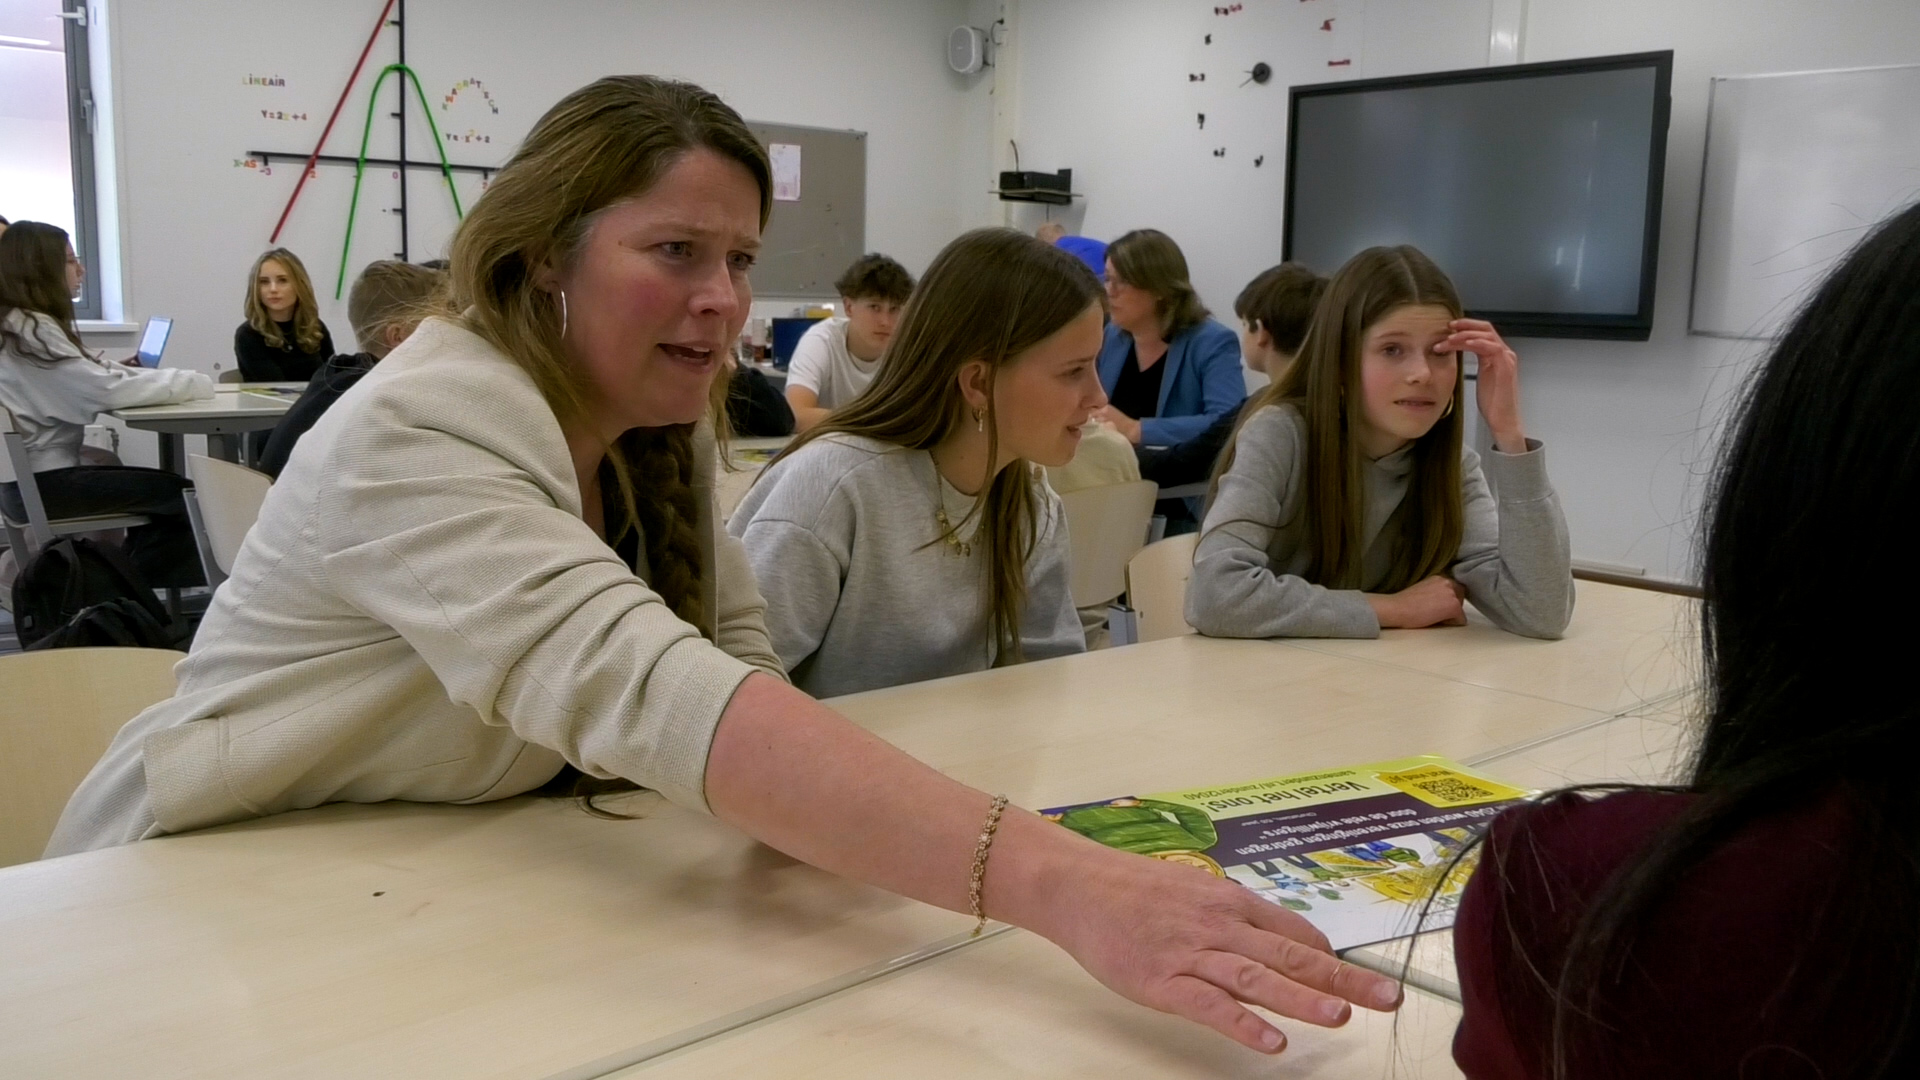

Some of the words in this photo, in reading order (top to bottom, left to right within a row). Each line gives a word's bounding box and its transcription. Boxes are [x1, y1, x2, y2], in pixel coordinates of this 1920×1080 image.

[1299, 780, 1371, 799] Vertel
[1254, 789, 1300, 805] het
[1200, 797, 1252, 813] ons!
[1369, 813, 1388, 821] de
[1387, 808, 1418, 818] door
[1419, 812, 1466, 825] worden
[1344, 815, 1370, 826] vele
[1391, 819, 1421, 831] onze
[1304, 825, 1389, 844] verenigingen
[1234, 838, 1304, 856] gedragen
